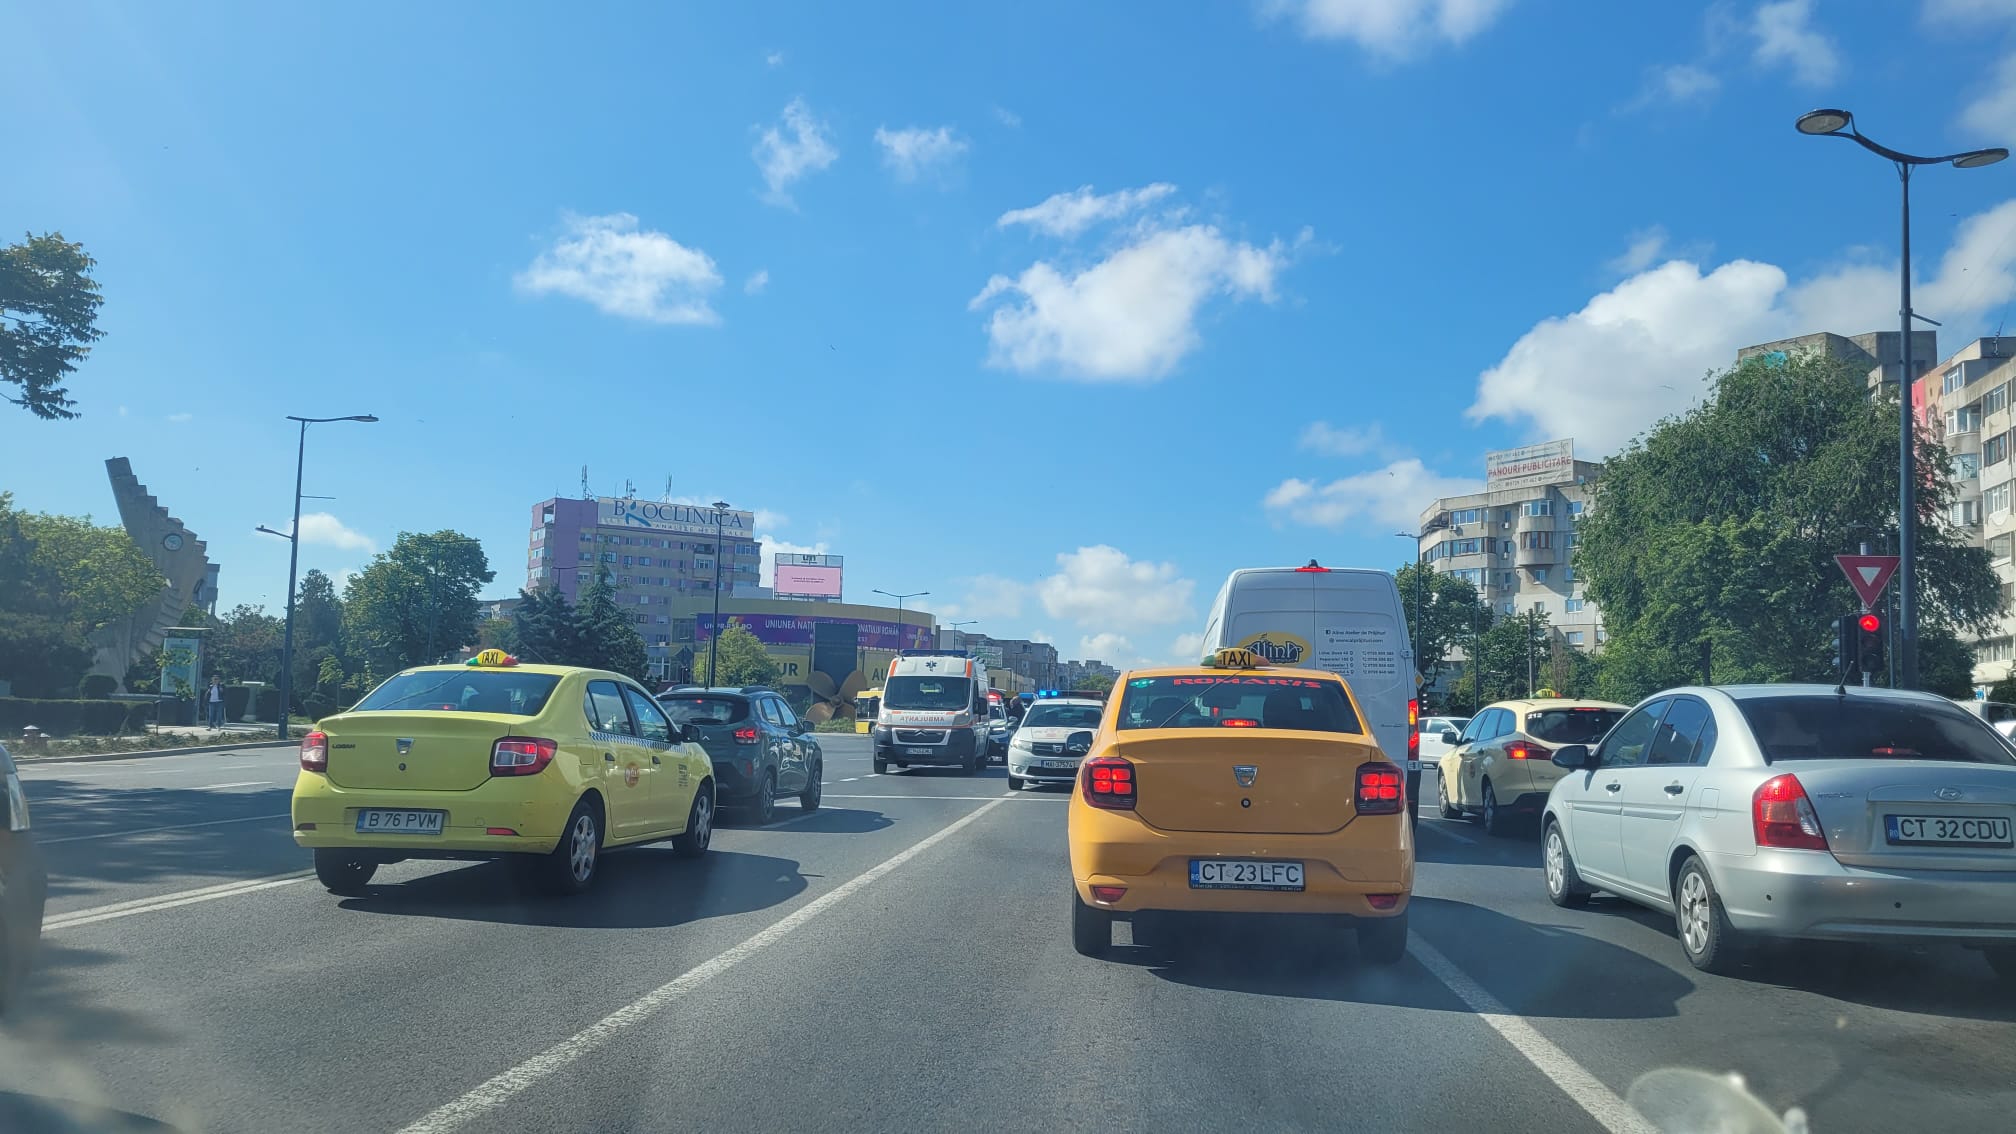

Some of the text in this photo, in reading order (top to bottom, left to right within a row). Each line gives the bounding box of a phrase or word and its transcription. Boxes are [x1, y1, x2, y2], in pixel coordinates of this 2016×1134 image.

[1488, 455, 1572, 478] PANOURI PUBLICITARE
[765, 620, 796, 630] UNIUNEA
[482, 652, 499, 664] TAXI
[1221, 651, 1251, 666] TAXI
[369, 813, 438, 828] B 76 PVM
[1901, 819, 1926, 837] CT
[1202, 863, 1226, 881] CT
